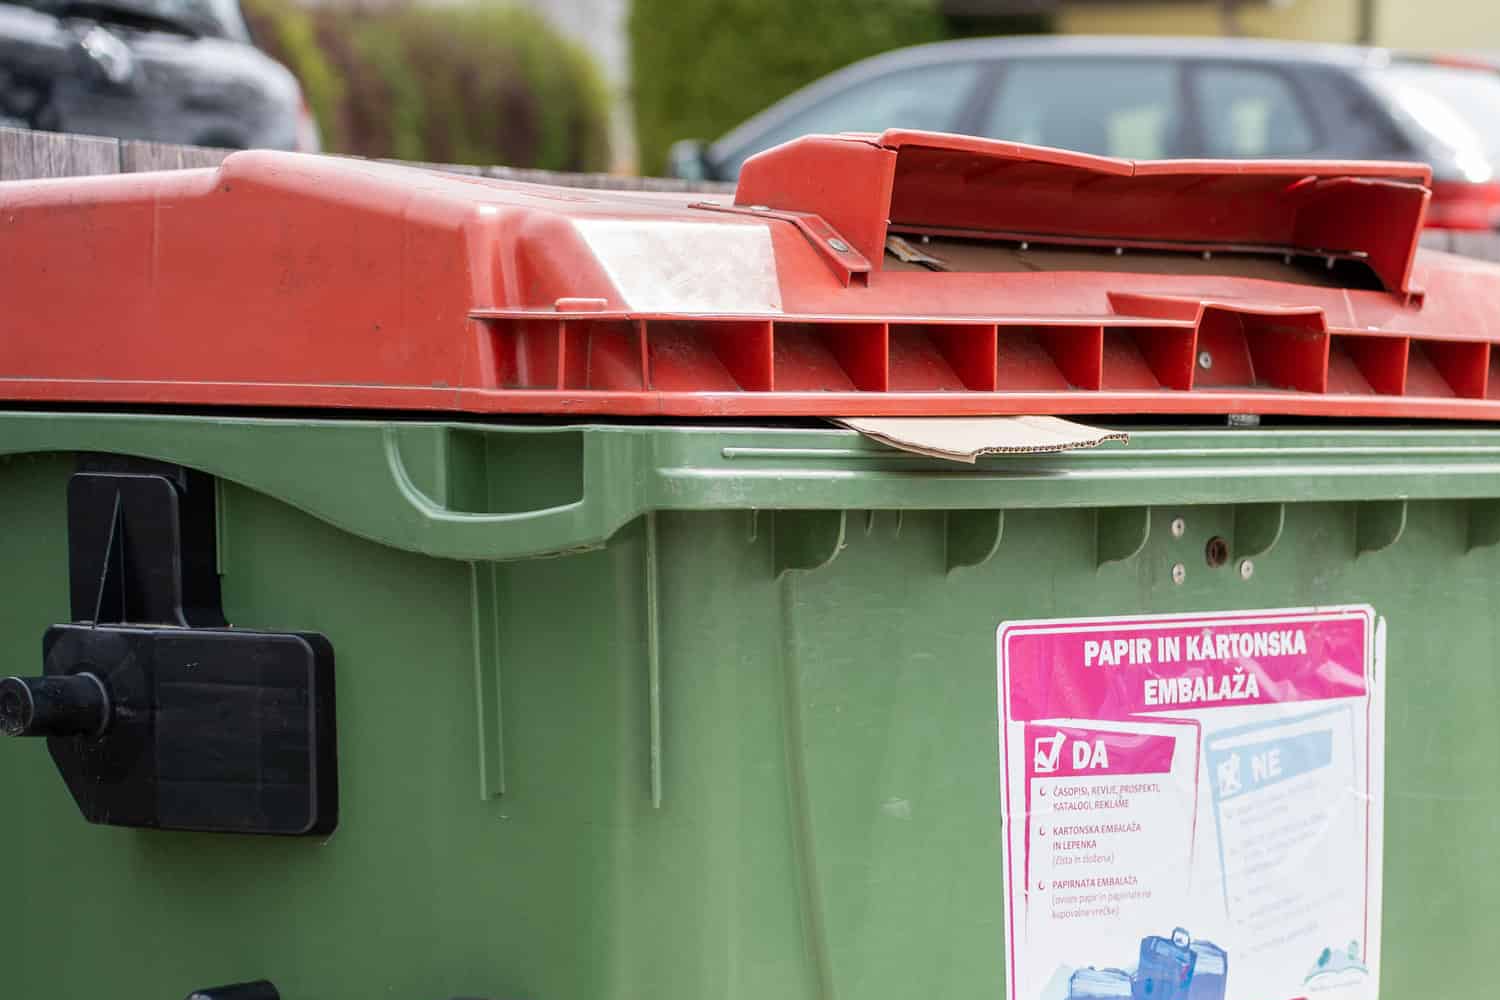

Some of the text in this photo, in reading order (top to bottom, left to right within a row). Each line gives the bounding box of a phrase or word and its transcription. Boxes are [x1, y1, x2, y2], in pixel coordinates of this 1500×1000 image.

[1084, 629, 1308, 667] PAPIR IN KARTONSKA
[1143, 666, 1260, 705] EMBALAŽA
[1072, 740, 1109, 770] DA
[1250, 748, 1282, 783] NE
[1052, 821, 1142, 836] KARTONSKA EMBALAŽA
[1052, 839, 1097, 851] IN LEPENKA
[1052, 879, 1096, 889] PAPIRNATA
